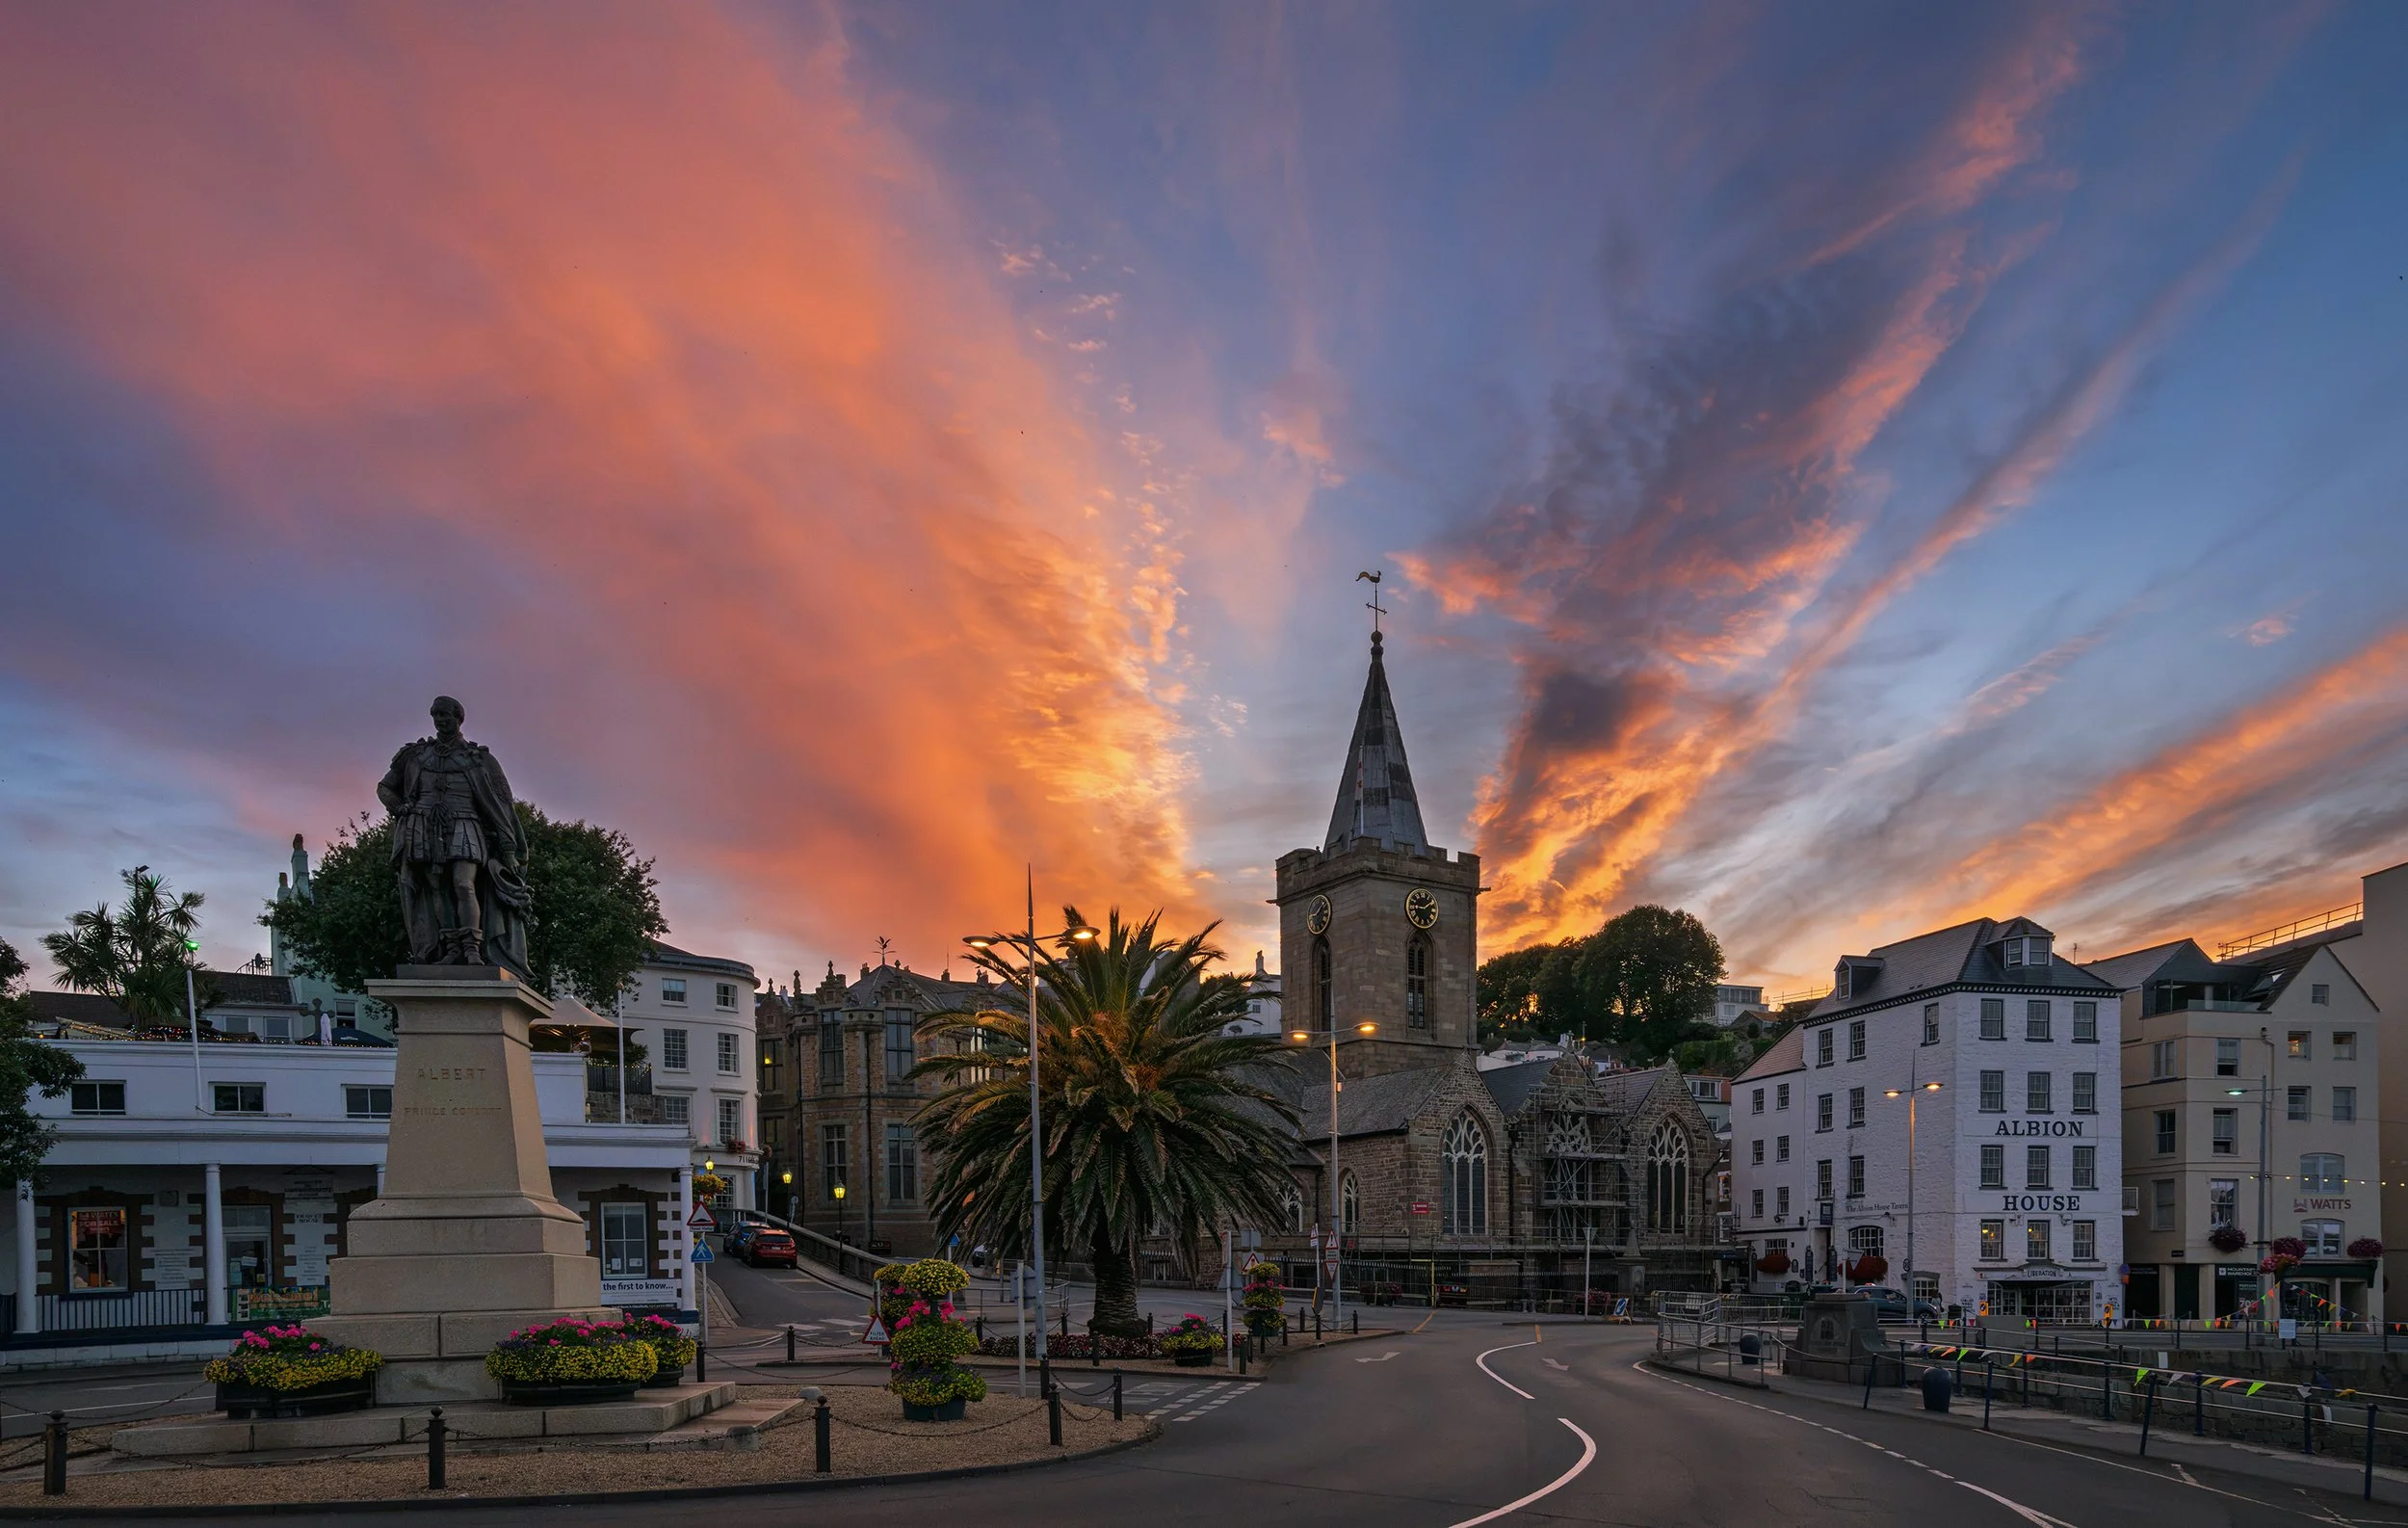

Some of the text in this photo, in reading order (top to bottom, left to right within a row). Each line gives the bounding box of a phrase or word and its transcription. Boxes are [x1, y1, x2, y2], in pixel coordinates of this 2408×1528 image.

[415, 1067, 486, 1080] ALBERT
[404, 1107, 446, 1116] PRINCE
[1995, 1120, 2083, 1137] ALBION
[2002, 1196, 2081, 1211] HOUSE
[2310, 1199, 2351, 1210] WATTS
[603, 1282, 616, 1291] the
[644, 1281, 673, 1290] know...
